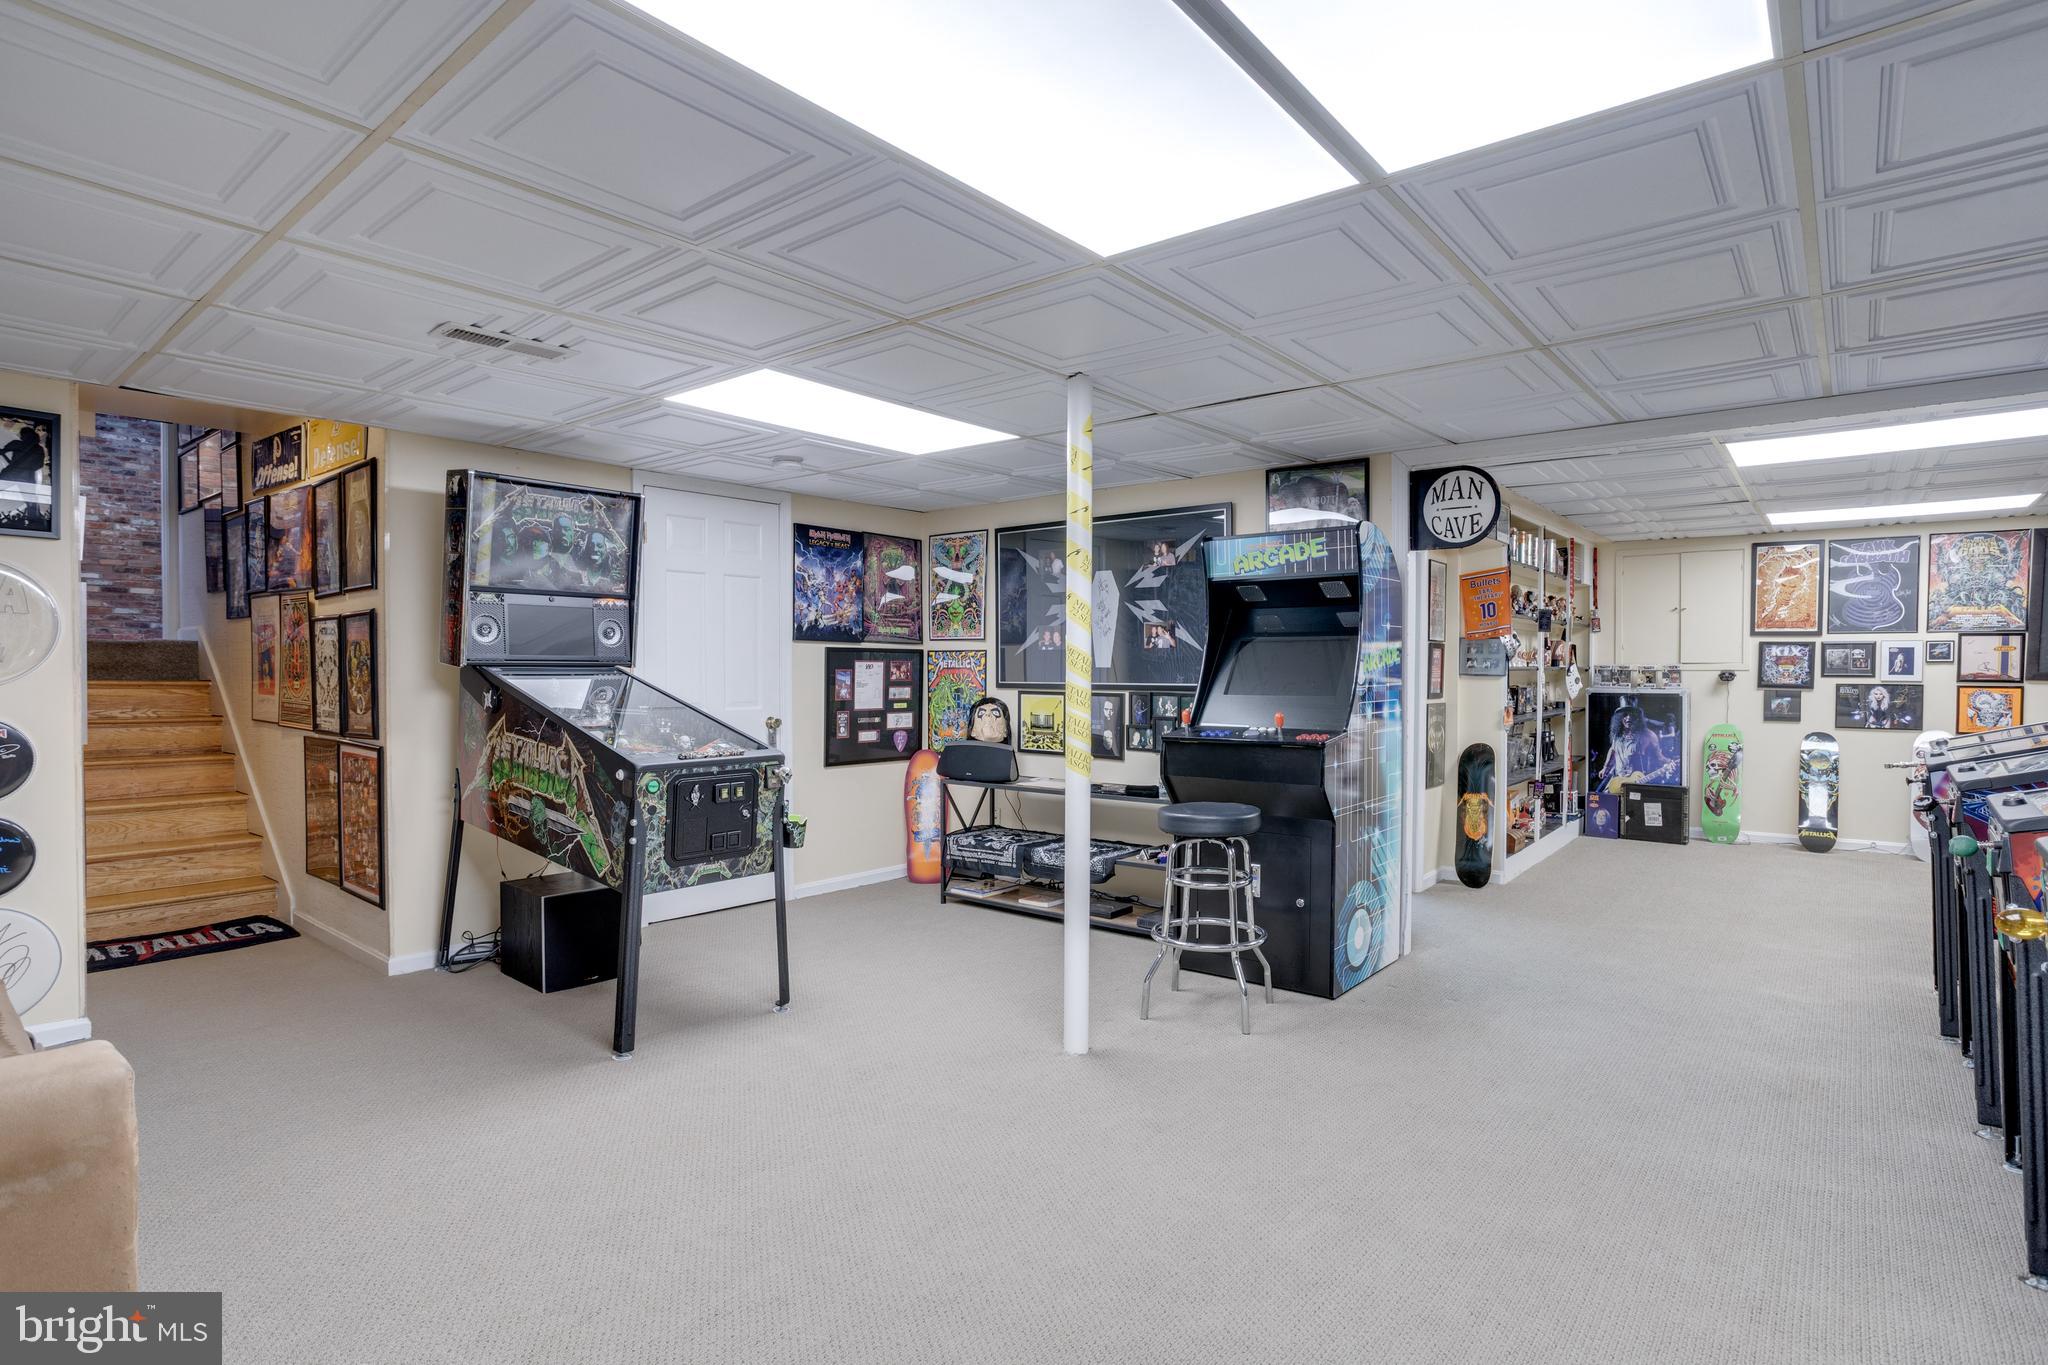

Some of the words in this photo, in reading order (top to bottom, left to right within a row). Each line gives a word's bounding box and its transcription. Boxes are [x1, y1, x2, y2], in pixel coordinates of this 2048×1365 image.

[313, 431, 361, 471] Defense!
[254, 455, 299, 488] Offense!
[1431, 475, 1485, 505] MAN
[1431, 513, 1484, 539] CAVE
[1233, 536, 1329, 574] ARCADE
[1470, 578, 1501, 589] Bullets
[1479, 601, 1497, 619] 10
[1771, 644, 1803, 656] KIX
